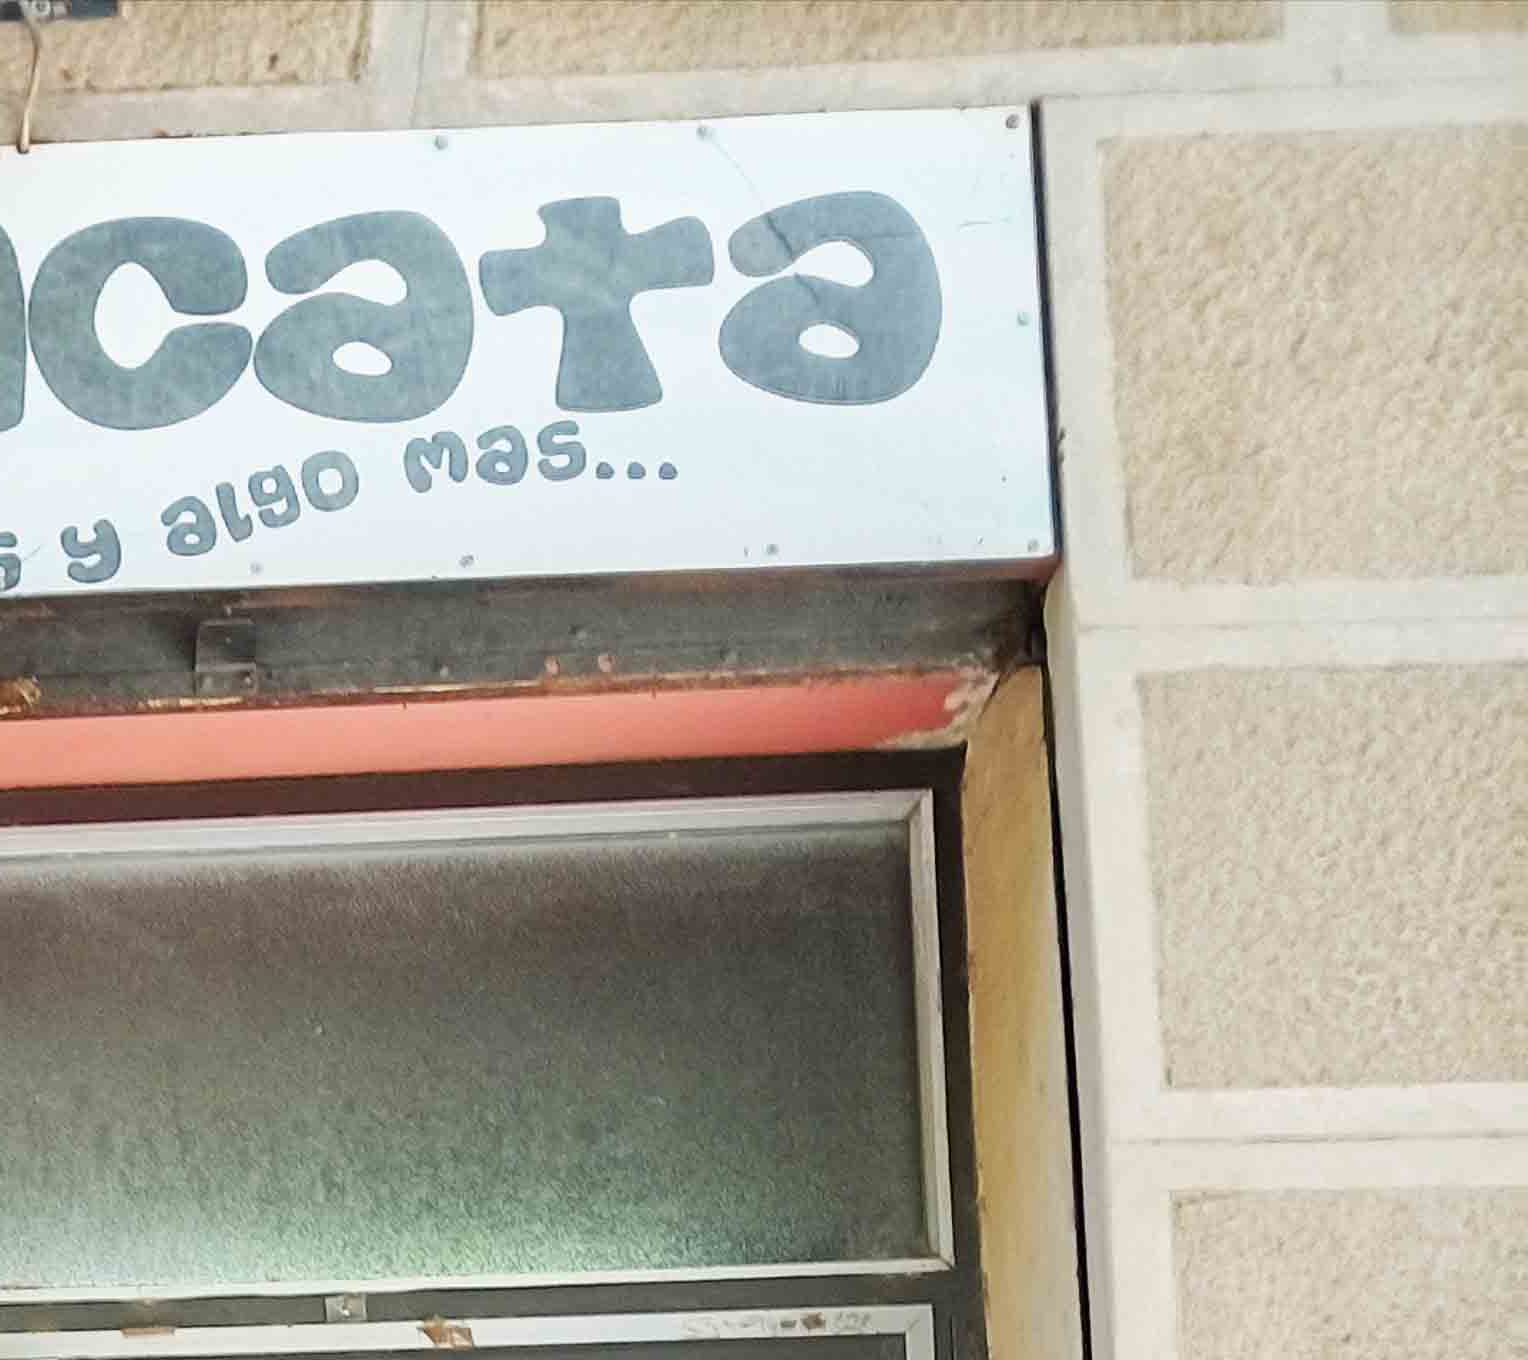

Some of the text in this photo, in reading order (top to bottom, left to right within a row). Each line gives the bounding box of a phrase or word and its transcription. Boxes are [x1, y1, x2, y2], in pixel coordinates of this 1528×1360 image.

[60, 519, 122, 583] y
[160, 450, 360, 557] algo
[404, 420, 679, 493] mas...
